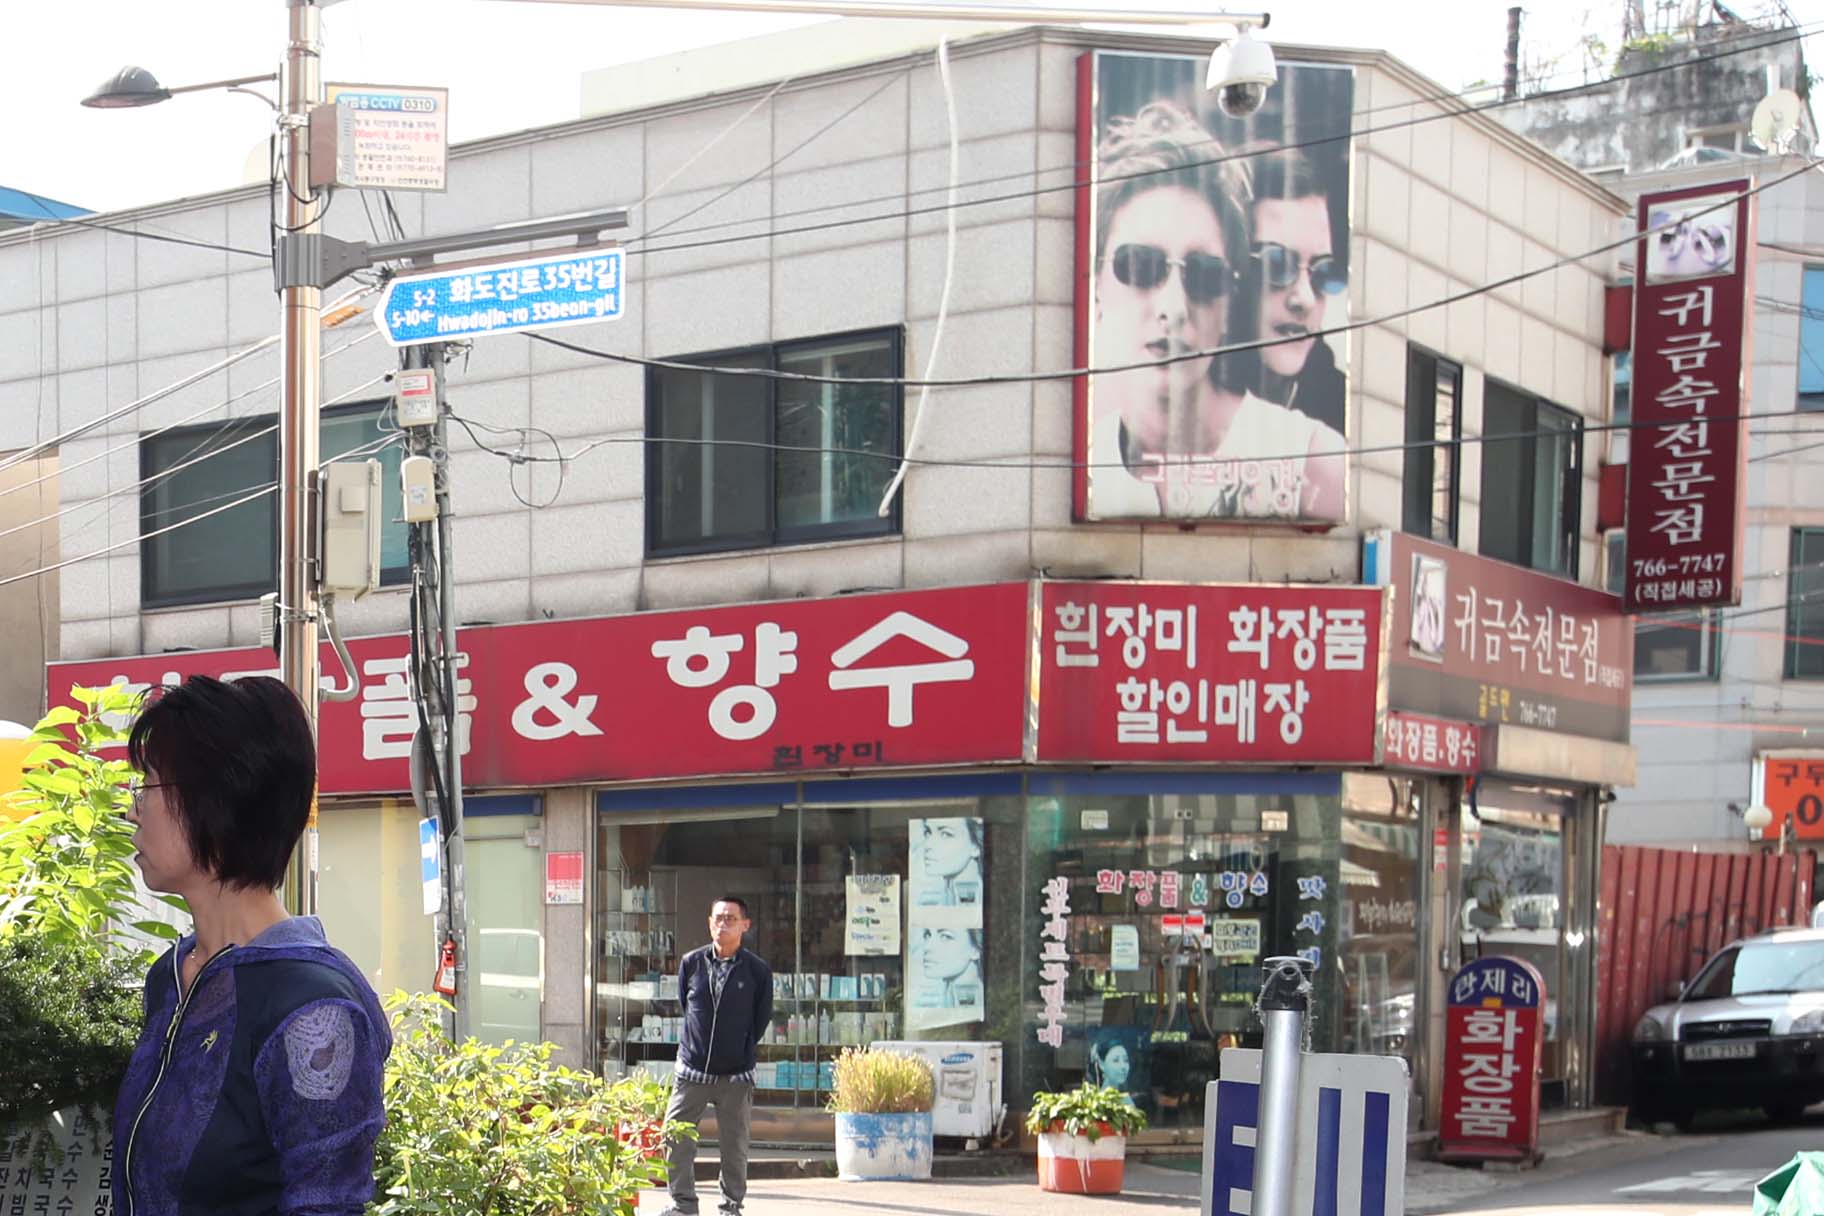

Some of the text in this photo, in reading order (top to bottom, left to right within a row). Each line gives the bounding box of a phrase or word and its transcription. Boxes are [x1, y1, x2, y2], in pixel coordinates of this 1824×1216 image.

[370, 98, 400, 109] CCTV
[404, 101, 432, 110] 0310
[438, 294, 615, 332] Hwadojin-ro 35beon-gil
[1650, 286, 1722, 546] 귀금속전문점
[1634, 554, 1726, 576] 766-7747
[1053, 603, 1368, 672] 흰장미 화장품
[1454, 586, 1600, 685] 귀금속전문점
[651, 611, 974, 742] 향수
[1115, 678, 1309, 745] 할인매장
[1453, 968, 1533, 1003] 란제리
[1454, 1009, 1524, 1139] 화장품
